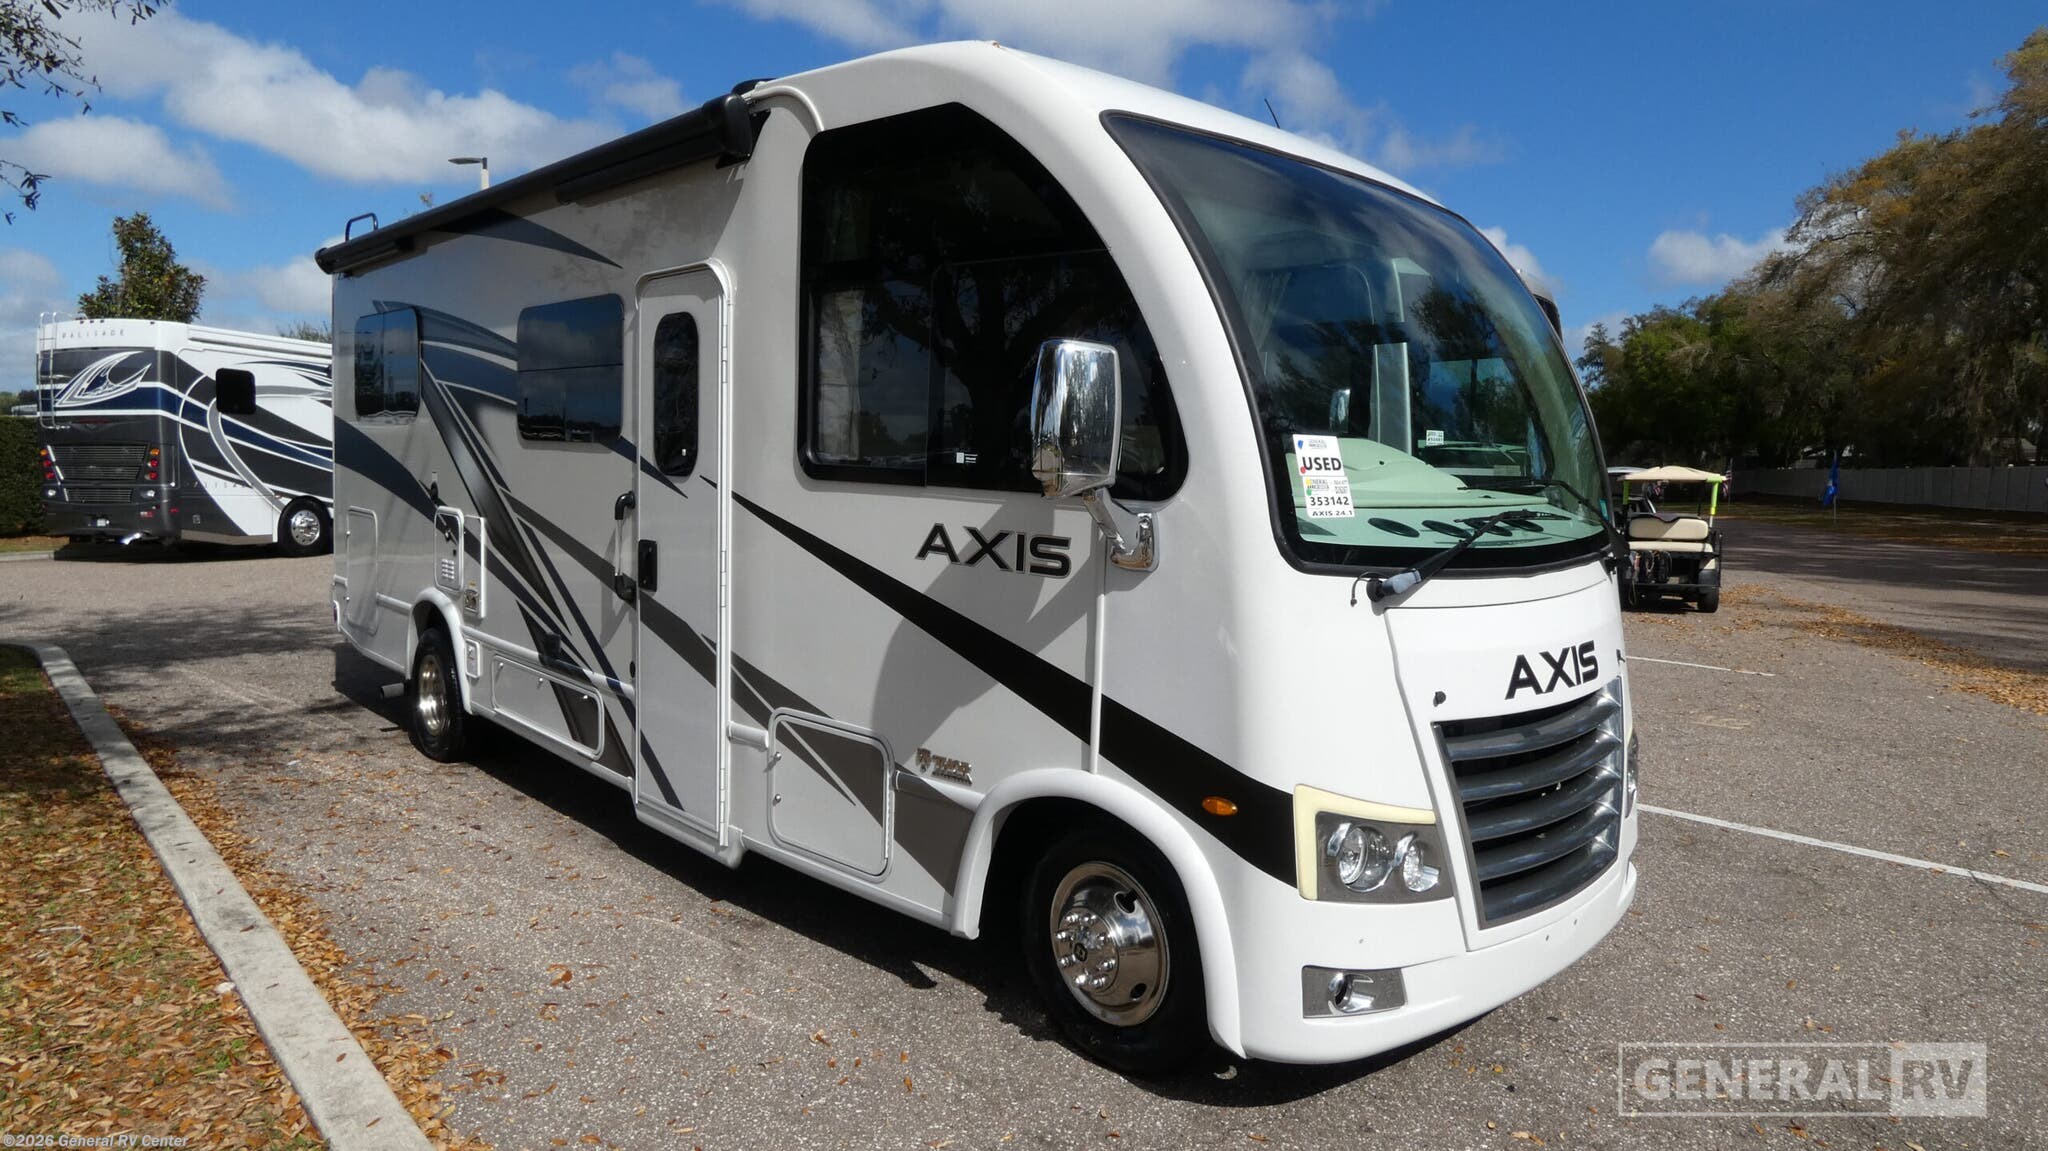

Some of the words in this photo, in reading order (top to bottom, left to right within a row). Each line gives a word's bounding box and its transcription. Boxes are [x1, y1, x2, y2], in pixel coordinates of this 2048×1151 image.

[61, 328, 125, 339] PALISADE
[1302, 456, 1342, 471] USED
[1309, 496, 1350, 506] 353142
[914, 522, 1072, 579] AXIS
[1504, 640, 1599, 699] AXIS
